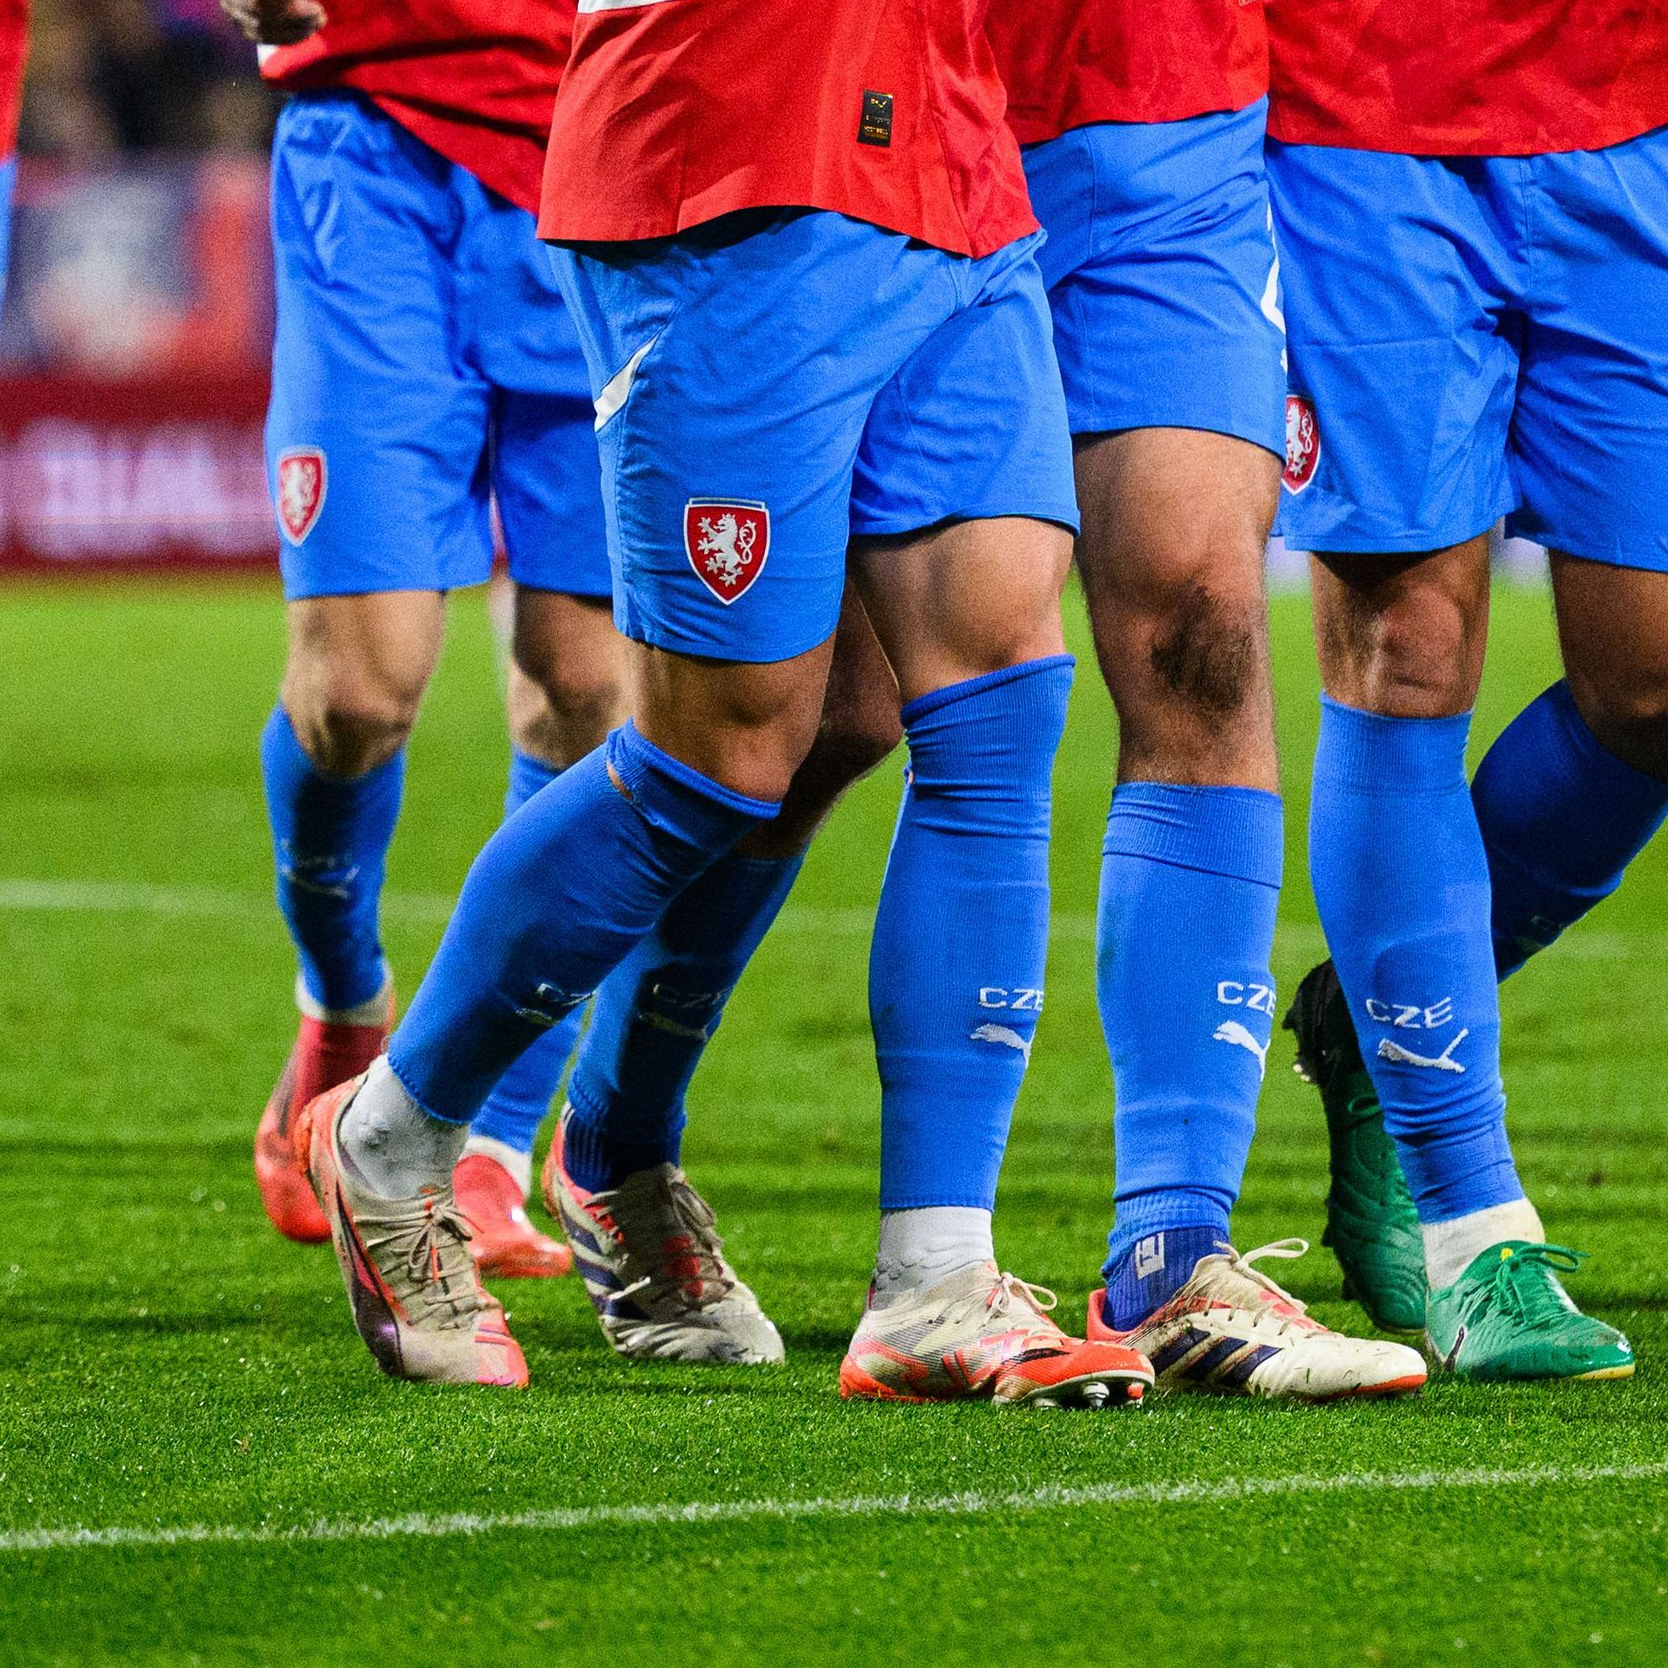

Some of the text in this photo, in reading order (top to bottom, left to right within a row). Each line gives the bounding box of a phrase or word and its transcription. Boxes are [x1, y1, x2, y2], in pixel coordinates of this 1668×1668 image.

[979, 987, 1044, 1012] CZE
[1217, 980, 1277, 1018] CZE
[1365, 996, 1453, 1029] CZE
